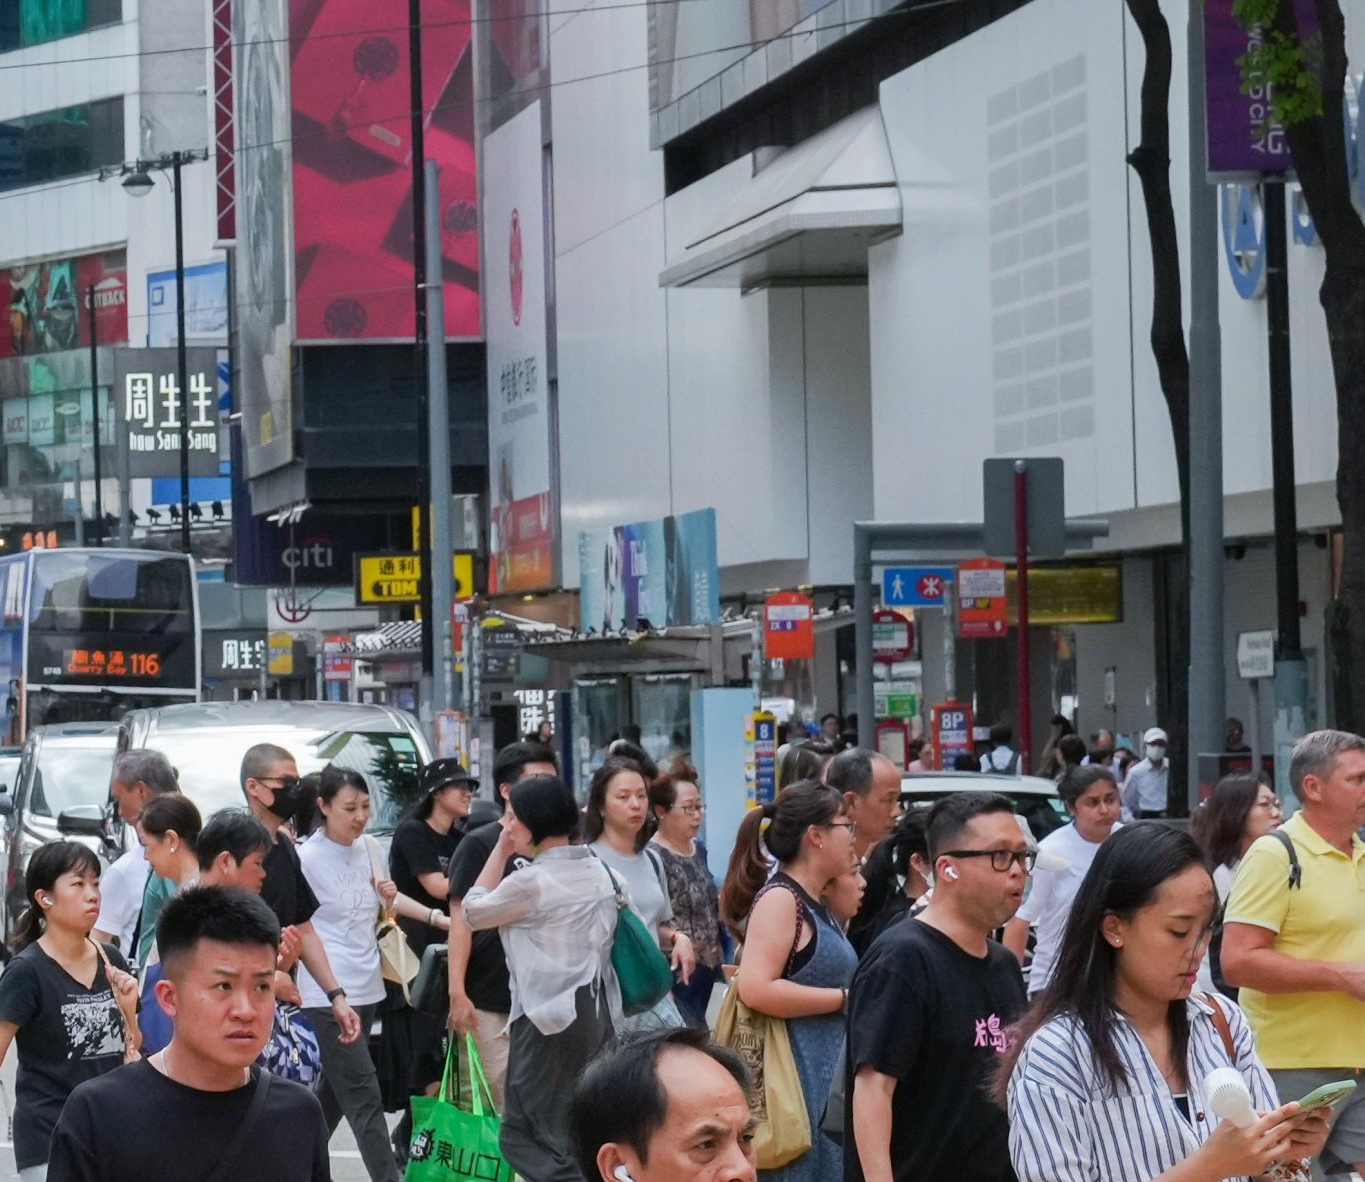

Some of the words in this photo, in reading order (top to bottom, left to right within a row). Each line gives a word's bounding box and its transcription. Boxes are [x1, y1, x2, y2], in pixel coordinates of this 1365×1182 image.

[126, 373, 214, 428] 周生生
[129, 432, 155, 451] how
[188, 430, 216, 453] Sang
[282, 543, 332, 568] citi
[379, 582, 418, 598] TOM
[131, 654, 159, 675] 116
[760, 723, 768, 739] 8
[942, 712, 964, 730] 8P
[436, 1139, 501, 1182] 東山口
